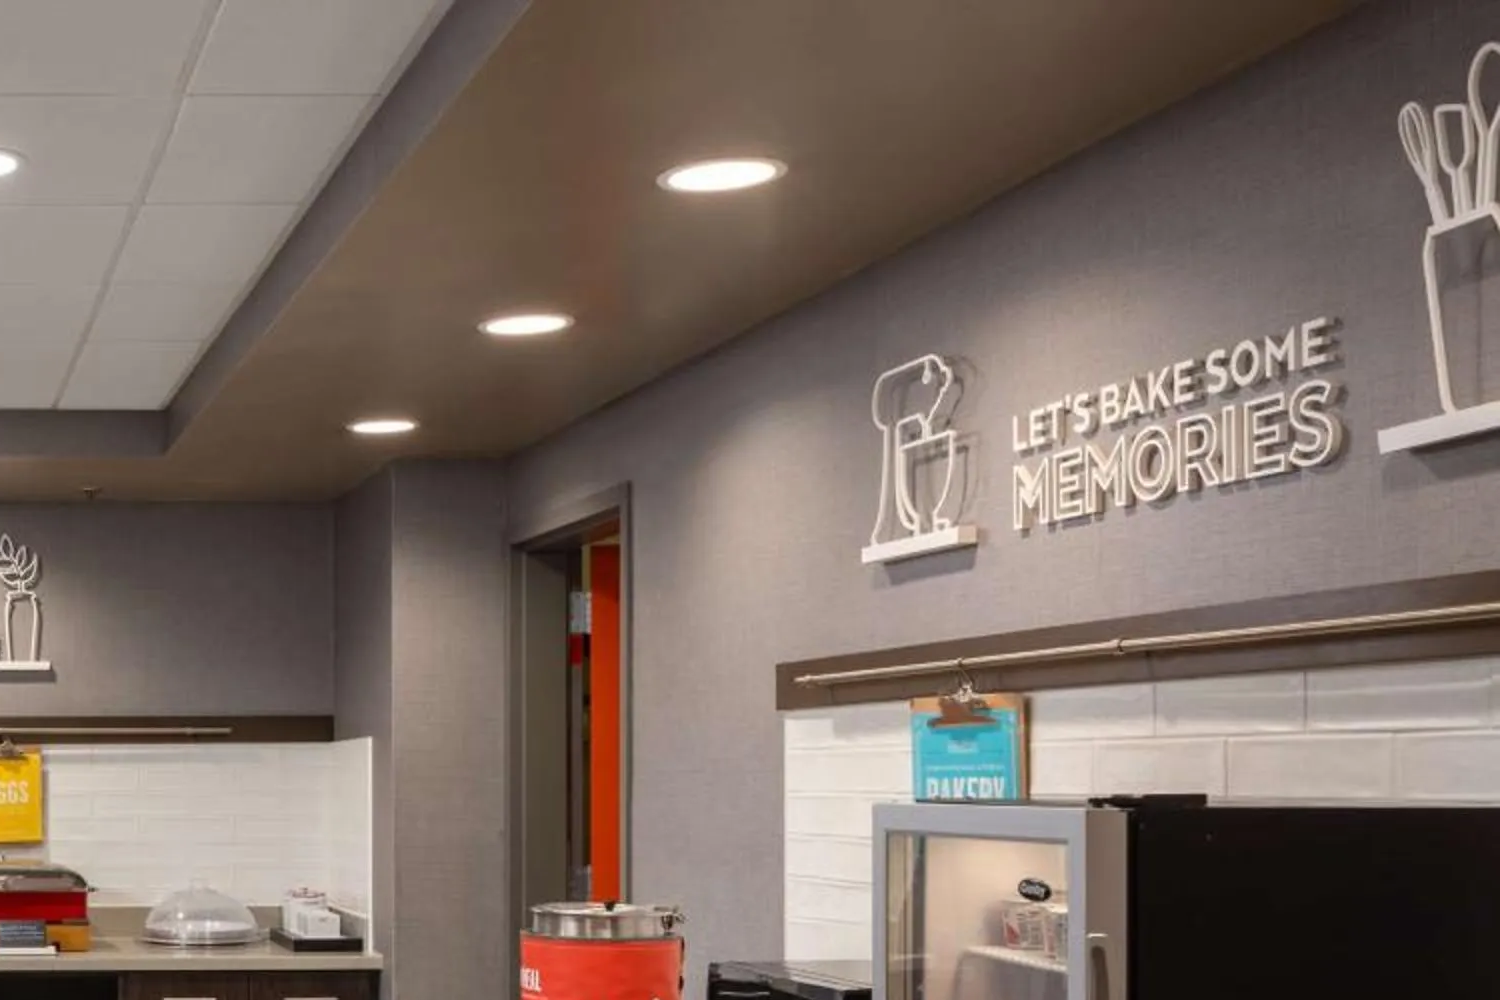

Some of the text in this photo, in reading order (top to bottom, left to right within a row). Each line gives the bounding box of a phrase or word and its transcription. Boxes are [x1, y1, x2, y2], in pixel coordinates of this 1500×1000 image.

[1012, 316, 1328, 451] LET'S BAKE SOME
[1013, 379, 1334, 530] MEMORIES
